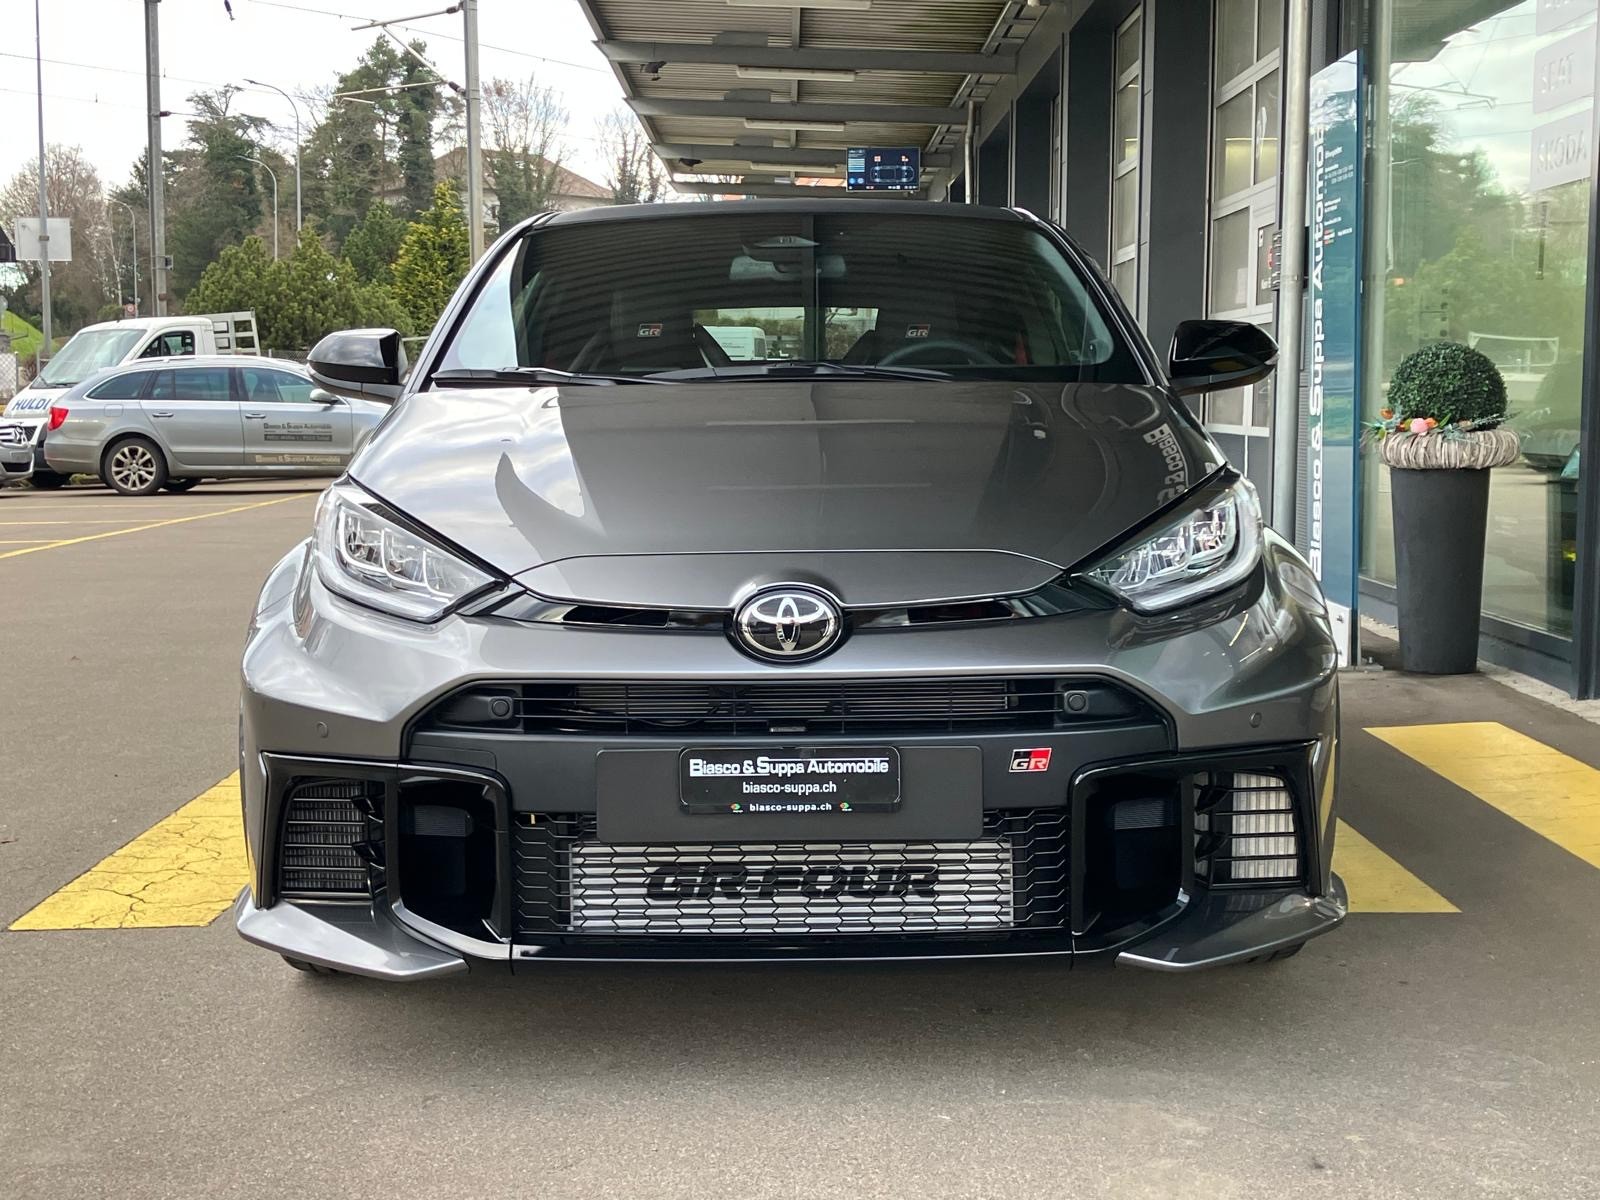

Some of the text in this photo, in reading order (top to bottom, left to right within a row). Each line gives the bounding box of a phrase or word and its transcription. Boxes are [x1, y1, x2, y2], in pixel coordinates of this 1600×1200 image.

[1540, 52, 1575, 94] SEAT
[640, 328, 660, 337] GR
[908, 329, 929, 337] GR
[1309, 92, 1326, 582] Biasco & Suppa Automob
[689, 756, 889, 777] Biasco & Suppa Automobile
[1012, 758, 1048, 770] GR
[742, 781, 837, 795] biasco-suppa.ch
[749, 802, 833, 812] biasco-suppa.ch
